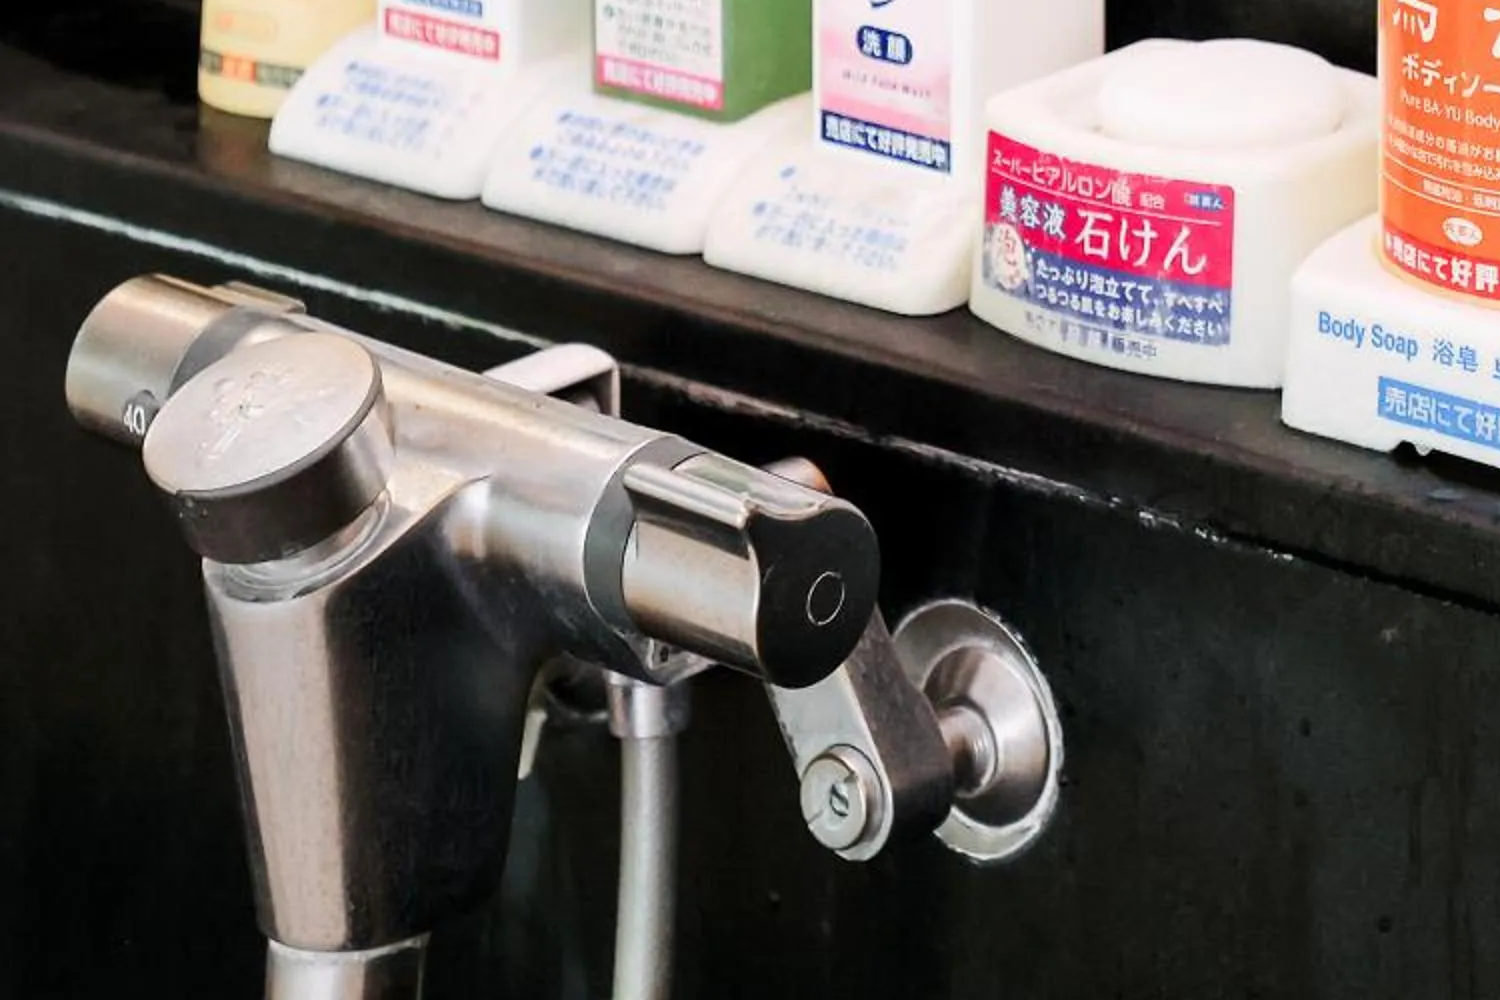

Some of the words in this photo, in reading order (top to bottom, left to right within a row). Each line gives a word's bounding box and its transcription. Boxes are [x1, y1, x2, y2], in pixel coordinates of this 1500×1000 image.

[861, 29, 907, 63] 洗顔
[1000, 183, 1067, 239] 美容液
[1075, 209, 1207, 276] 石けん
[1318, 310, 1366, 348] Body
[1371, 324, 1419, 361] Soap
[1432, 338, 1479, 373] 浴皂
[123, 403, 146, 436] 40
